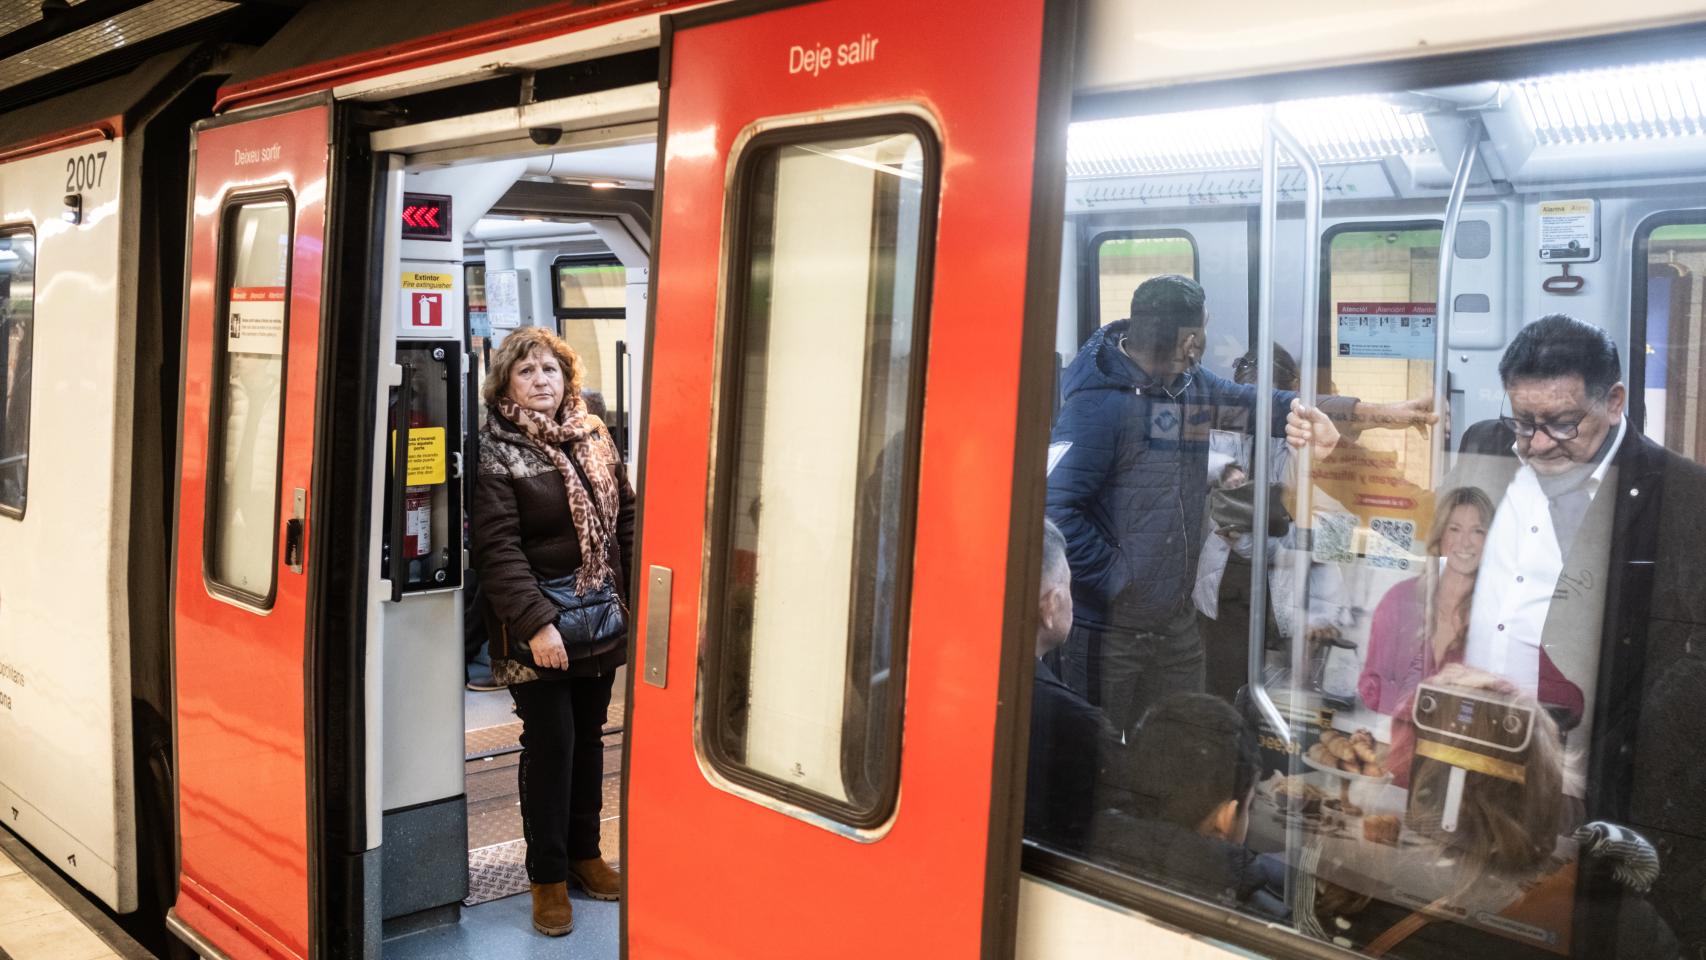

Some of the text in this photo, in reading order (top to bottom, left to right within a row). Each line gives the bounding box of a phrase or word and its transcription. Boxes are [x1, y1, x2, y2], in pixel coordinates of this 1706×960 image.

[788, 32, 880, 77] Deje salir
[66, 151, 108, 193] 2007
[234, 143, 282, 166] Deixeu sortir
